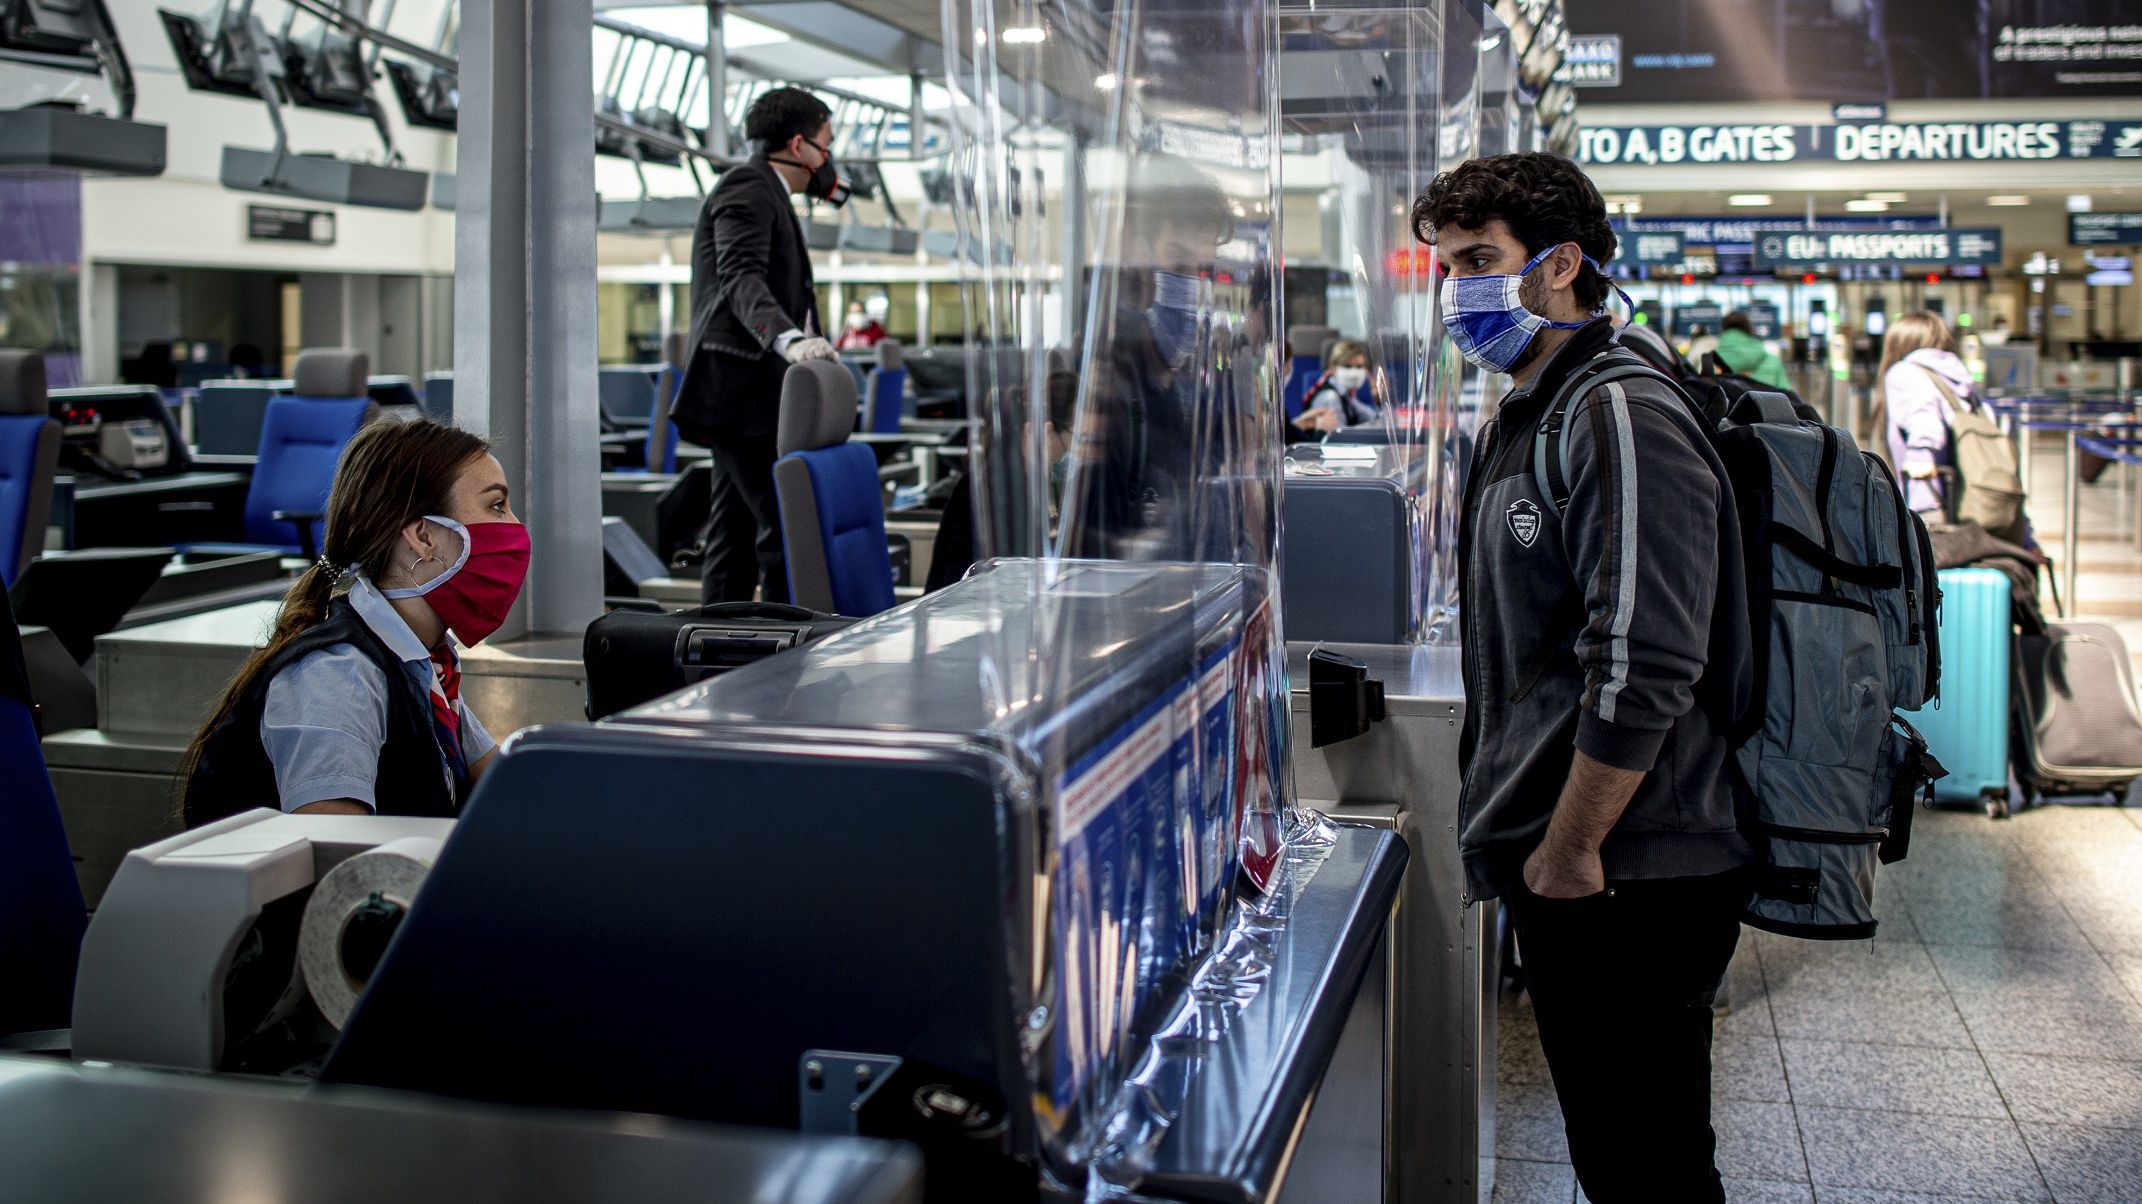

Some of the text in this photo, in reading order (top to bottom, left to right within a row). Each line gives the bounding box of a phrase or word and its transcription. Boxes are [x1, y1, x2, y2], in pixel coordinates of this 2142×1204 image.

[1580, 128, 1620, 163] TO
[1690, 126, 1796, 162] GATES
[1835, 123, 2060, 160] DEPARTURES
[1829, 233, 1950, 259] PASSPORTS
